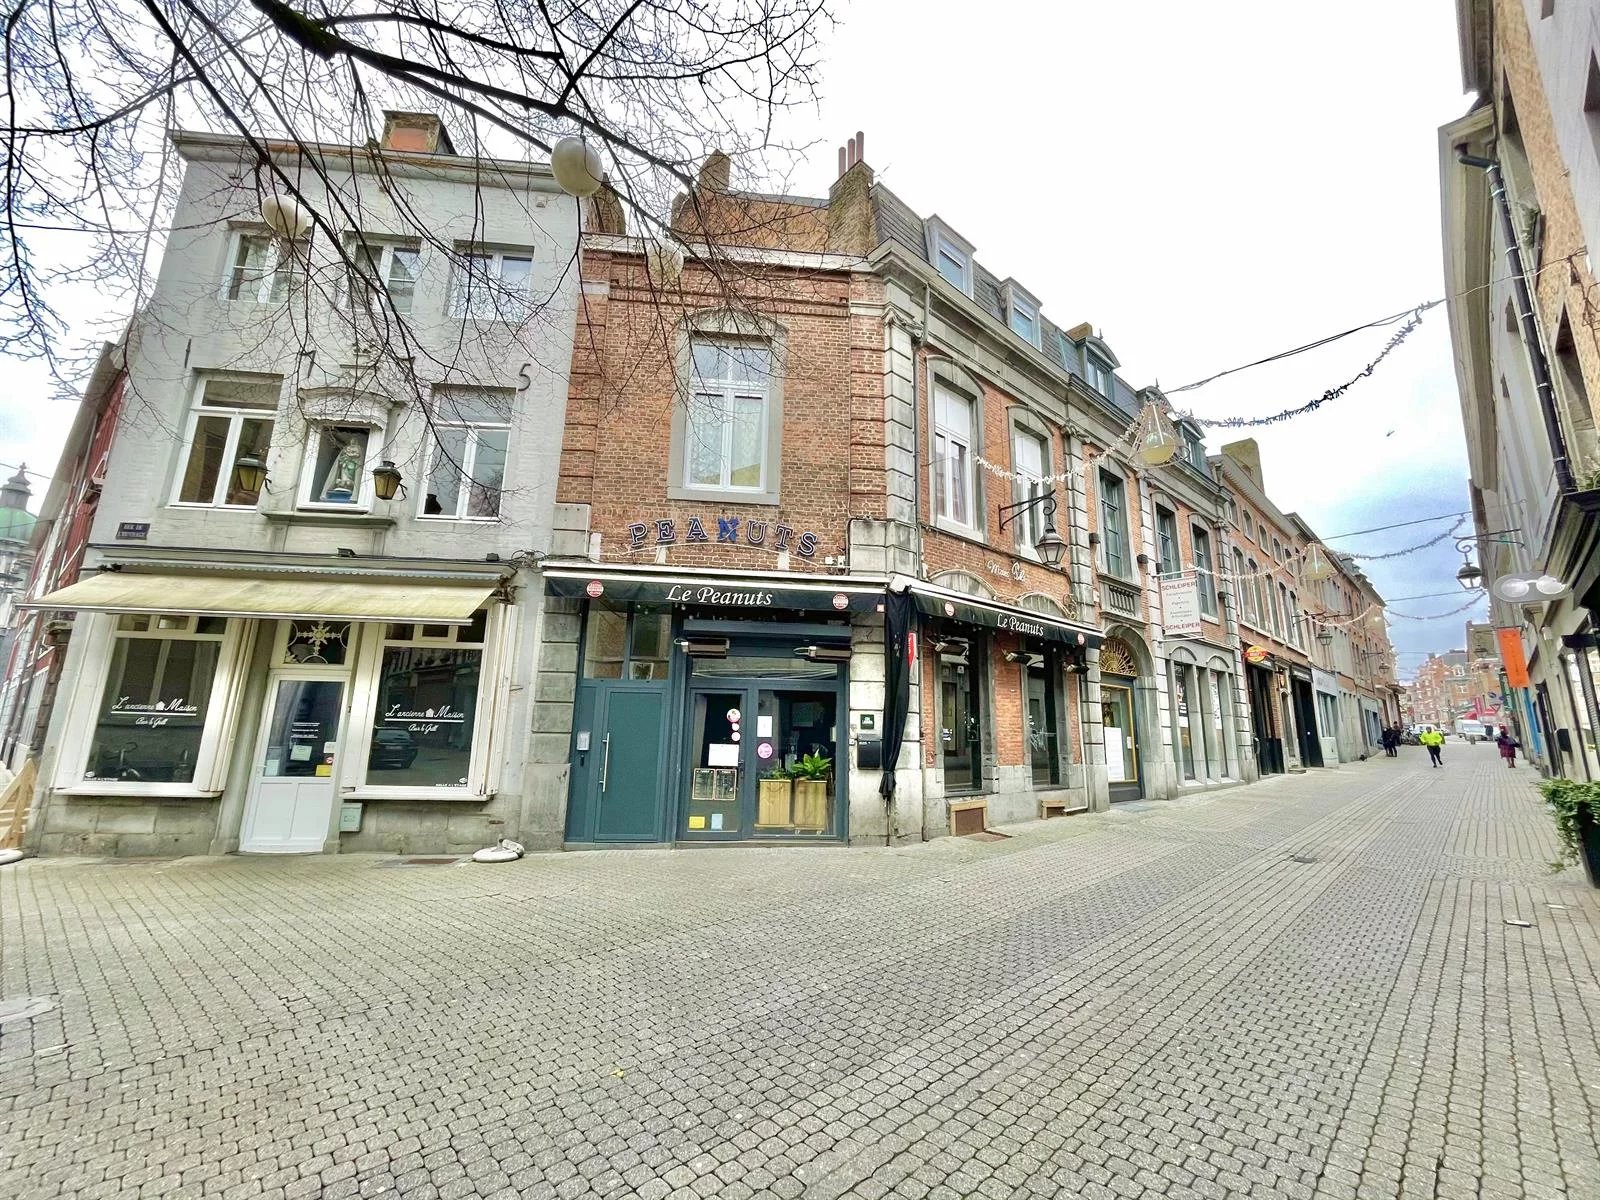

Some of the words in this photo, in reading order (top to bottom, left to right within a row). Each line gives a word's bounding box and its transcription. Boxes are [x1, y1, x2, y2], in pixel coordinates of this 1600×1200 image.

[628, 516, 817, 557] PEANUTS
[1161, 581, 1196, 591] SCHLEIPER
[665, 584, 692, 602] Le
[696, 586, 773, 606] Peanuts
[997, 613, 1008, 628] Le
[1009, 616, 1044, 637] Peanuts
[1165, 622, 1201, 631] SCHLEIPER
[164, 698, 198, 712] Maison
[433, 705, 465, 718] Maison
